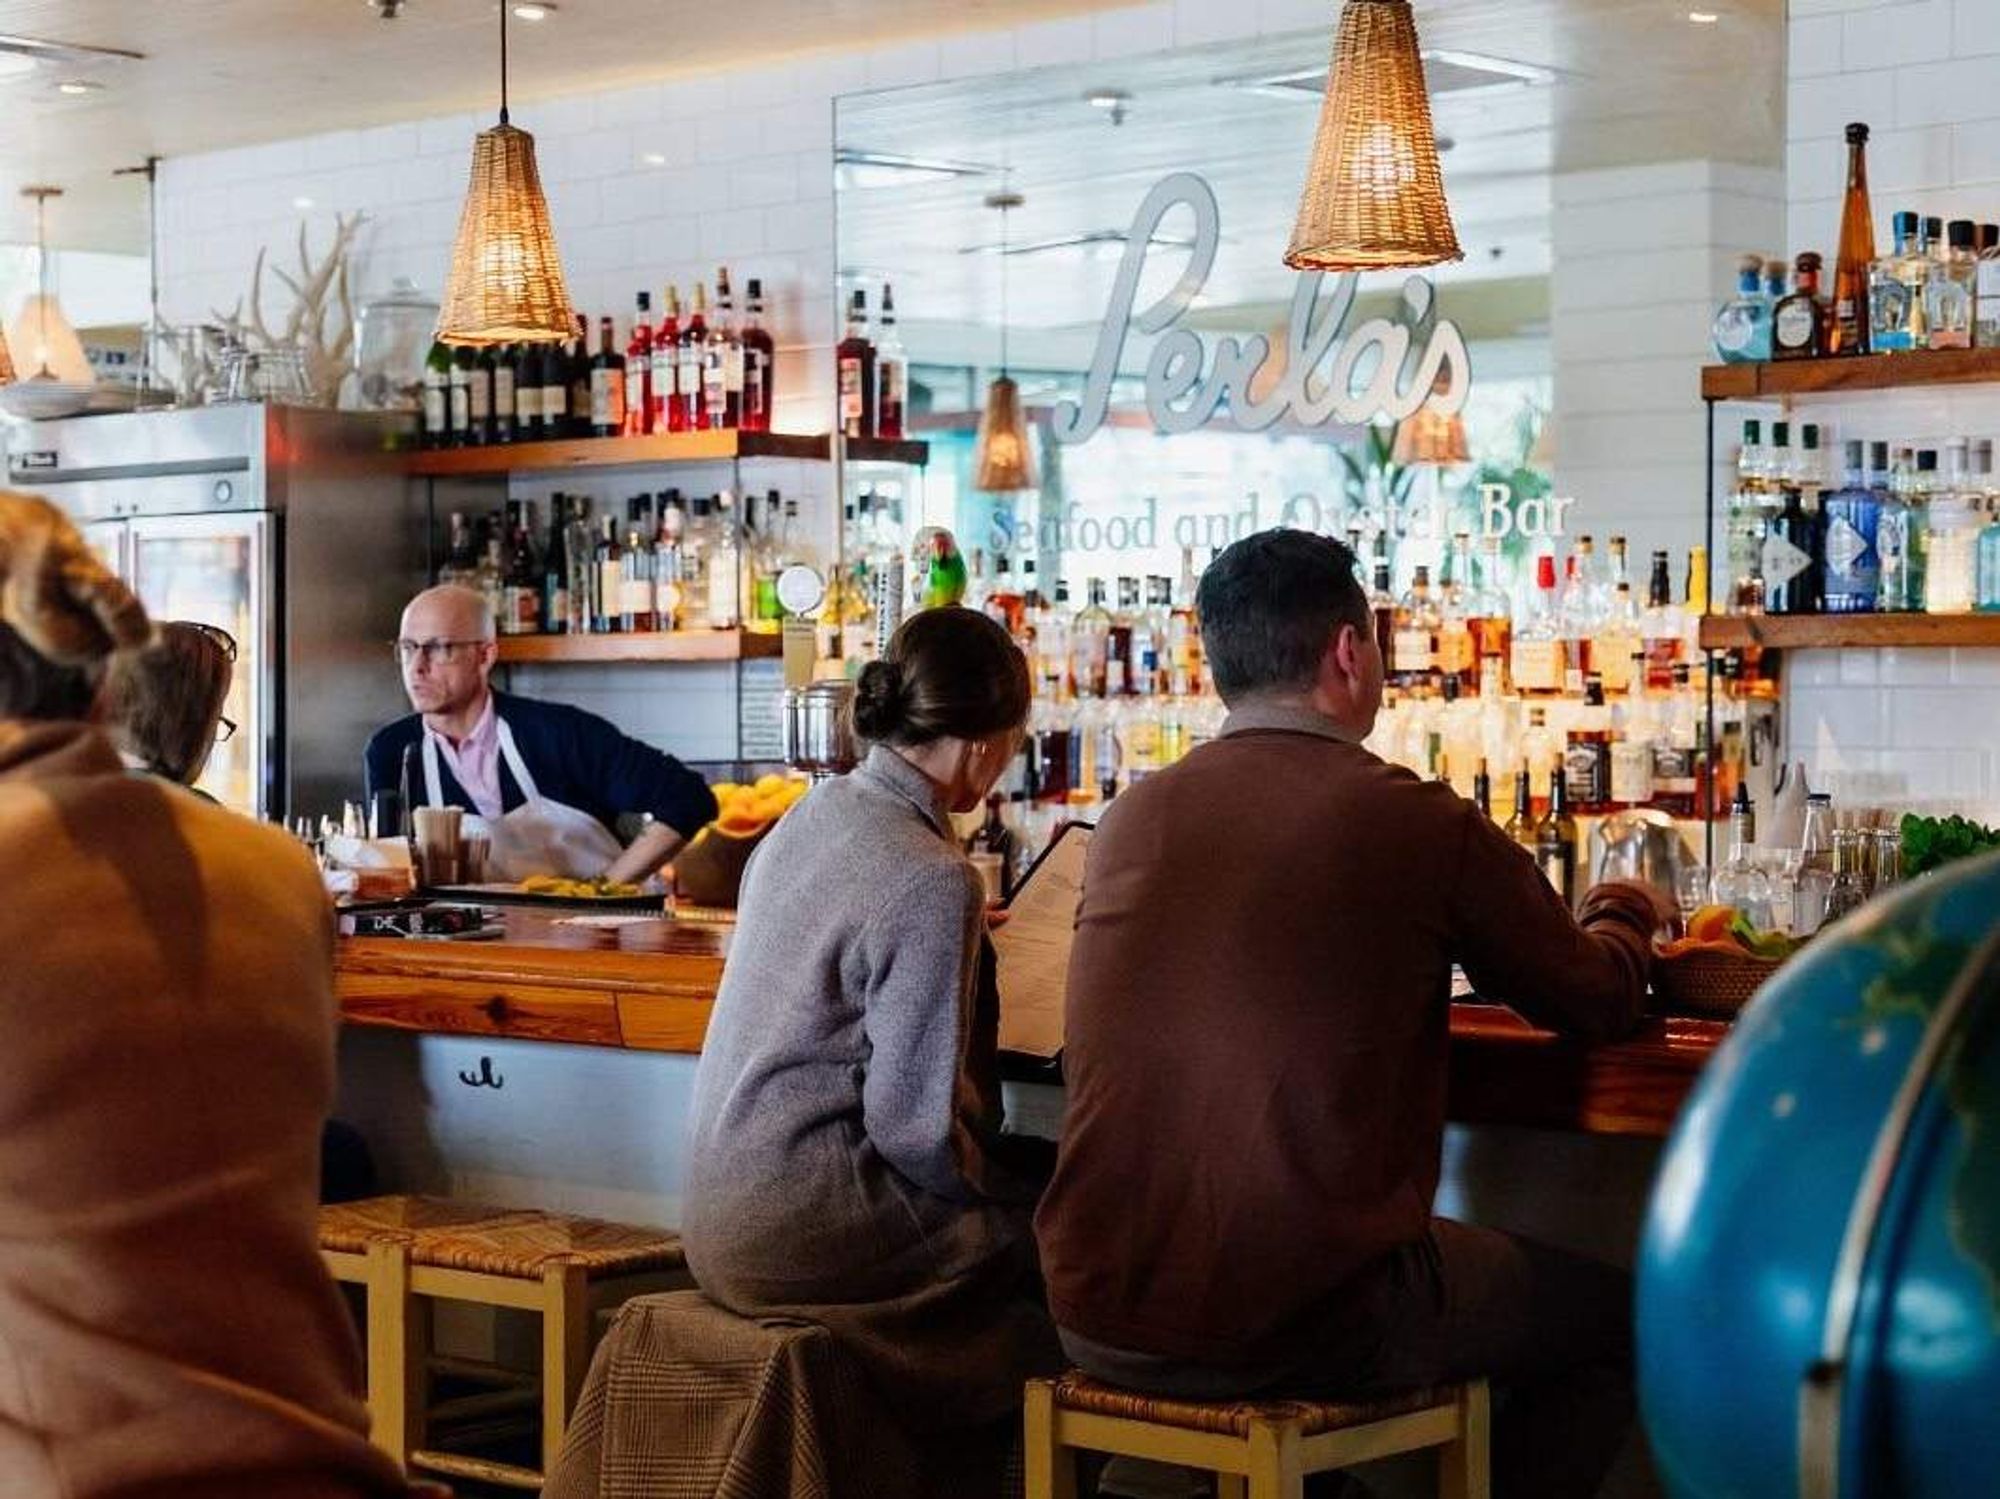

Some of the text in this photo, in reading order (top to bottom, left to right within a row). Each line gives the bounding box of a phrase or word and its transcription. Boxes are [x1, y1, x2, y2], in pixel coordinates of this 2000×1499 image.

[1053, 172, 1470, 443] Perla's
[989, 482, 1574, 554] Seafood and Oster Bar
